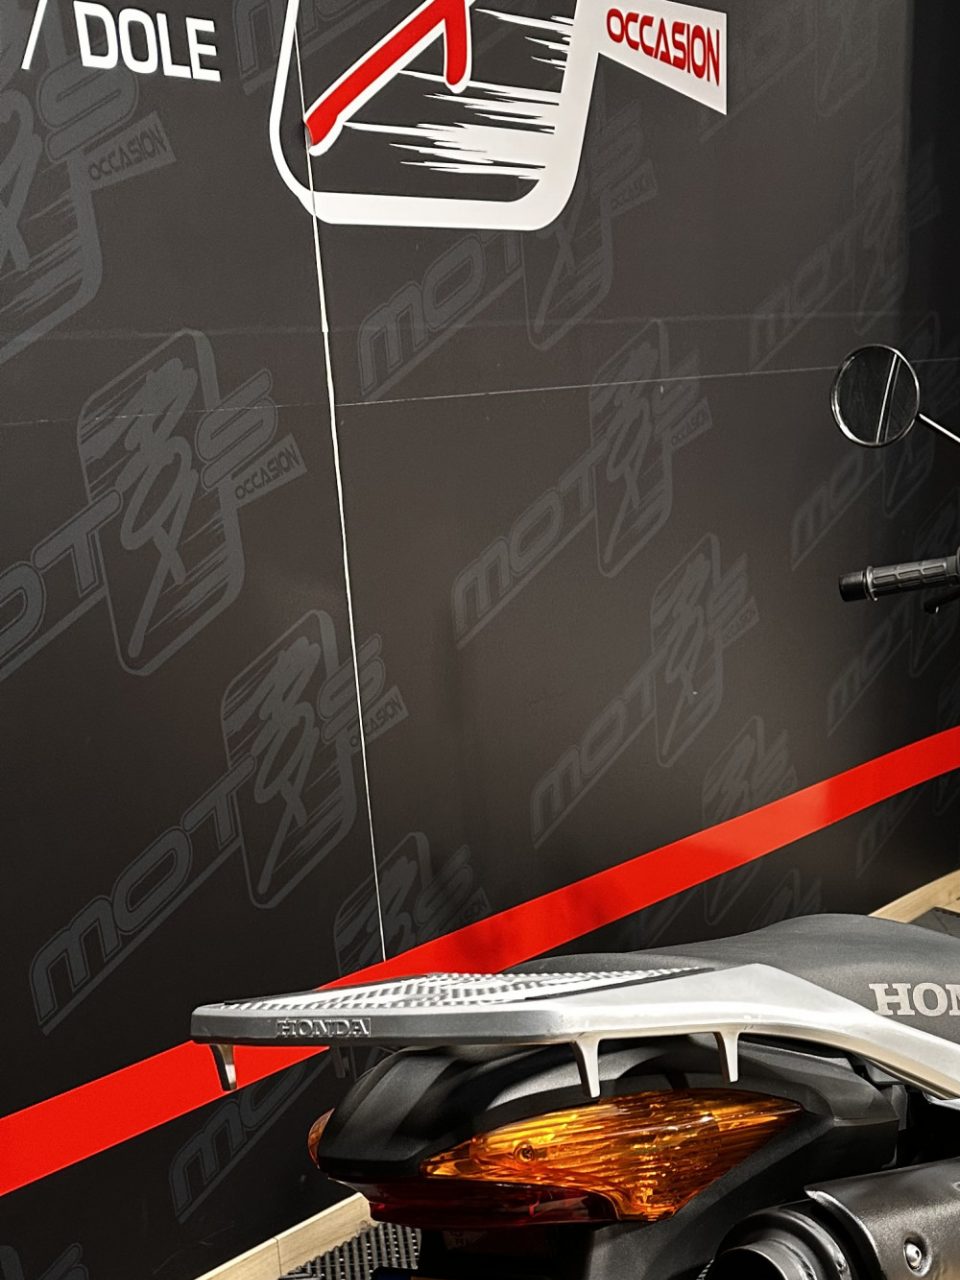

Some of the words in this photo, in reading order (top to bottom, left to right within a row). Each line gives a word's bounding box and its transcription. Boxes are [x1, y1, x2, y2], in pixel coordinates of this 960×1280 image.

[73, 0, 222, 83] DOLE
[606, 7, 721, 86] OCCASION
[87, 127, 168, 182] OCCASION
[234, 443, 301, 501] OCCASION
[350, 694, 404, 748] OCASION
[277, 1018, 370, 1038] HONDA
